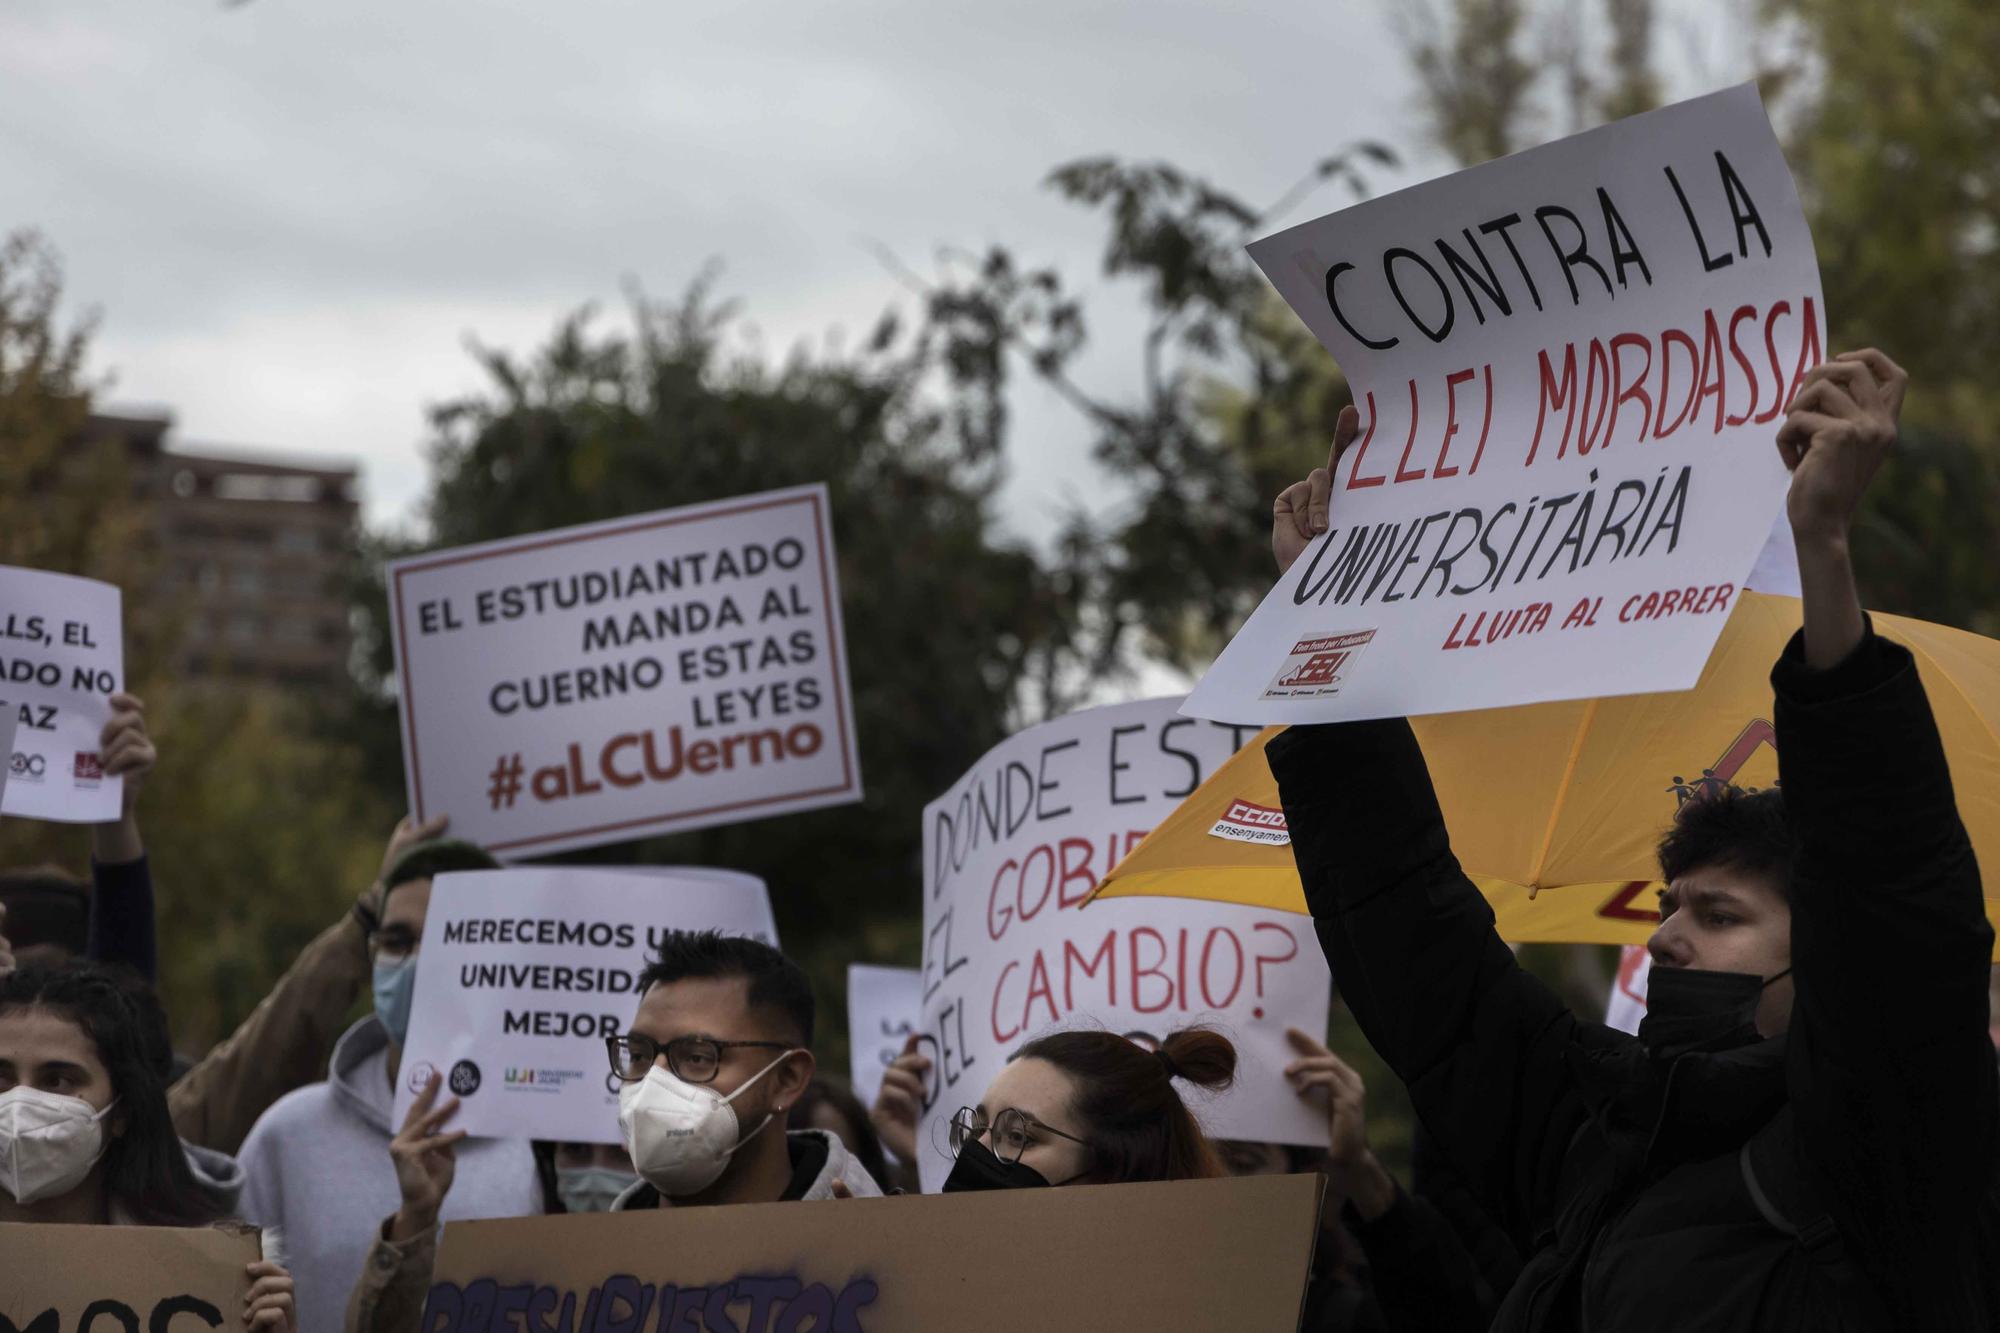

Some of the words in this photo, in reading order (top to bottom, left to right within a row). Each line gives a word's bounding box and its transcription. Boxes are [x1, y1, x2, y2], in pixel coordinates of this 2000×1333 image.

[1326, 186, 1653, 350] CONTRA
[1664, 149, 1773, 273] LA
[1346, 365, 1494, 491] LLEI
[1525, 296, 1822, 467] MORDASSA
[418, 601, 462, 635] EL
[476, 537, 805, 625] ESTUDIANTADO
[582, 595, 744, 653] MANDA
[758, 585, 811, 623] AL
[1442, 602, 1553, 650] LLUITA
[1561, 597, 1604, 630] AL
[1618, 582, 1735, 624] CARRER
[0, 613, 52, 647] LS,
[63, 620, 97, 649] EL
[71, 665, 115, 694] NO
[489, 657, 664, 716] CUERNO
[679, 629, 817, 683] ESTAS
[692, 677, 822, 729] LEYES
[488, 721, 824, 810] #aLCUerno
[1110, 718, 1265, 806] EST
[1214, 823, 1289, 842] ensenyamen
[443, 918, 636, 949] MERECEMOS
[922, 906, 969, 1004] EL
[502, 1010, 621, 1039] MEJOR
[919, 996, 976, 1116] DEL
[990, 921, 1299, 1045] CAMBIO?
